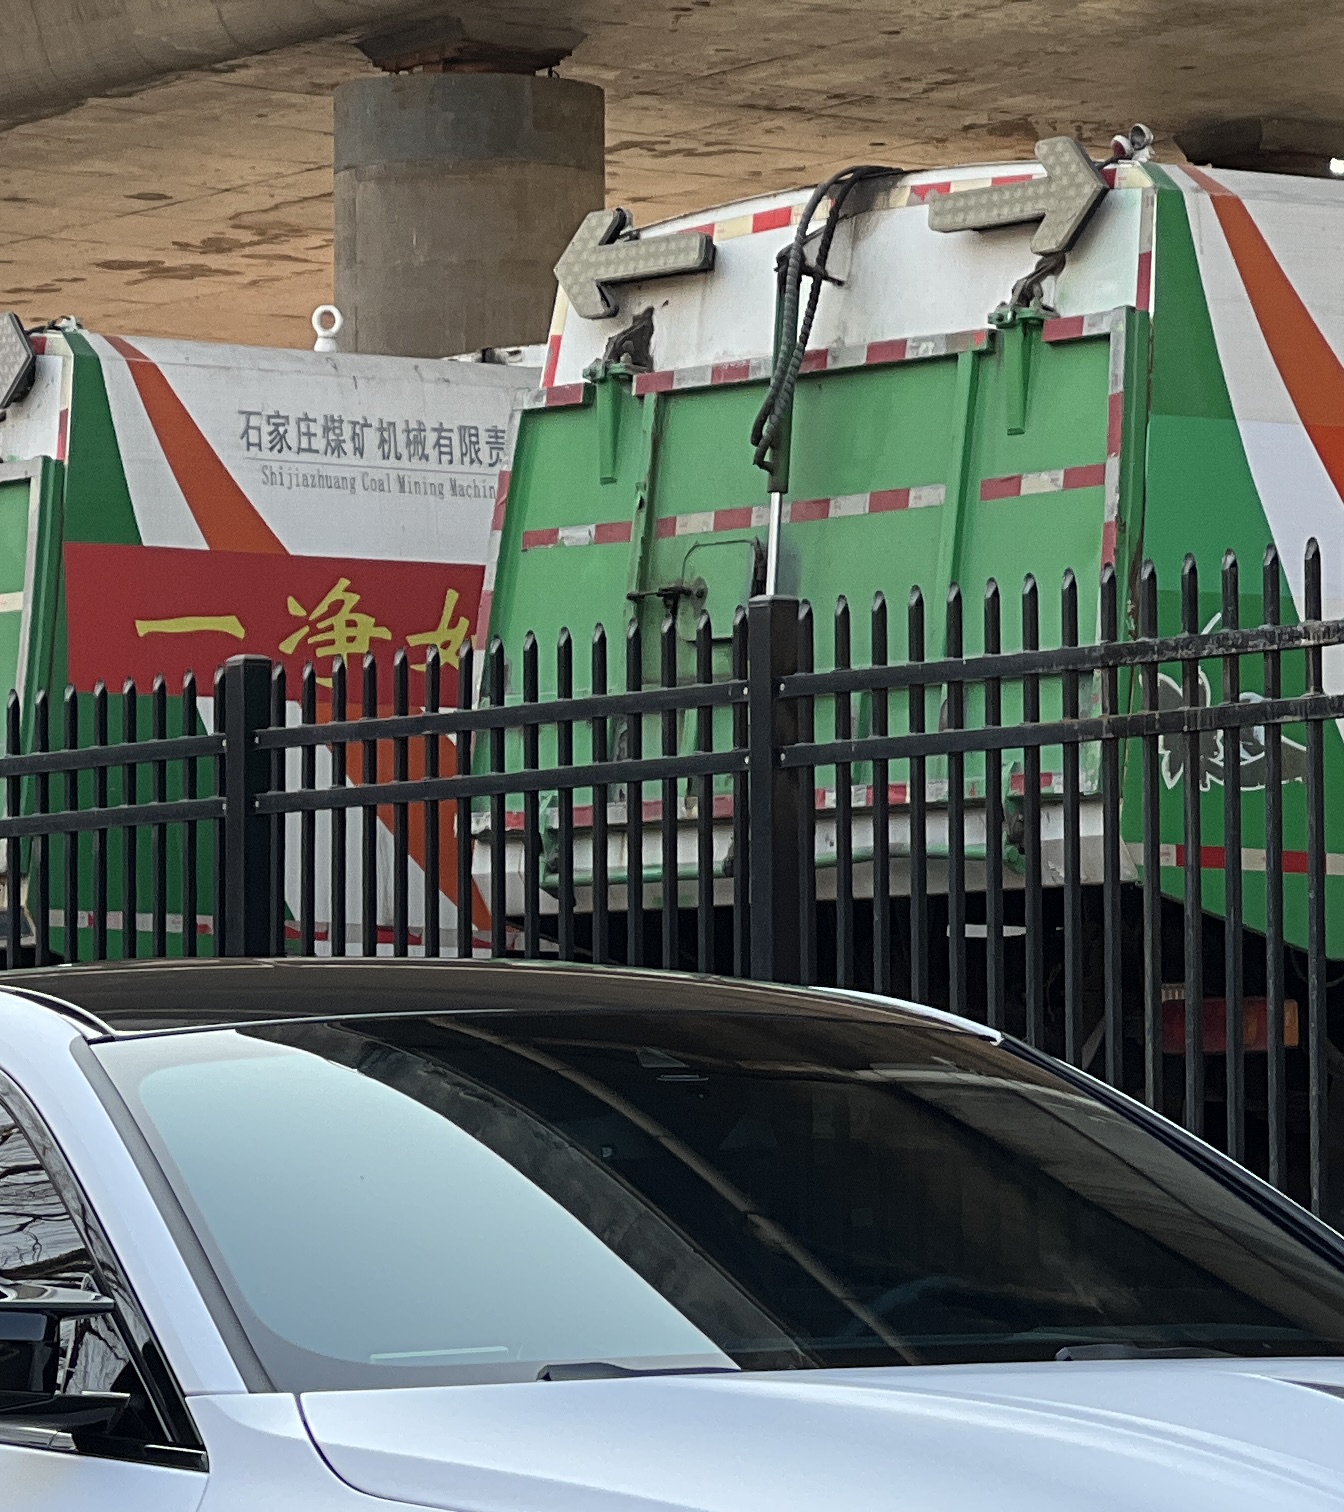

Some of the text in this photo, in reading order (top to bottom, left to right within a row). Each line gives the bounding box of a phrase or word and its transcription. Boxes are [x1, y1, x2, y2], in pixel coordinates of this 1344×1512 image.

[261, 464, 356, 494] Shijiazhuang
[361, 471, 392, 493] Coal
[397, 473, 444, 499] Mining
